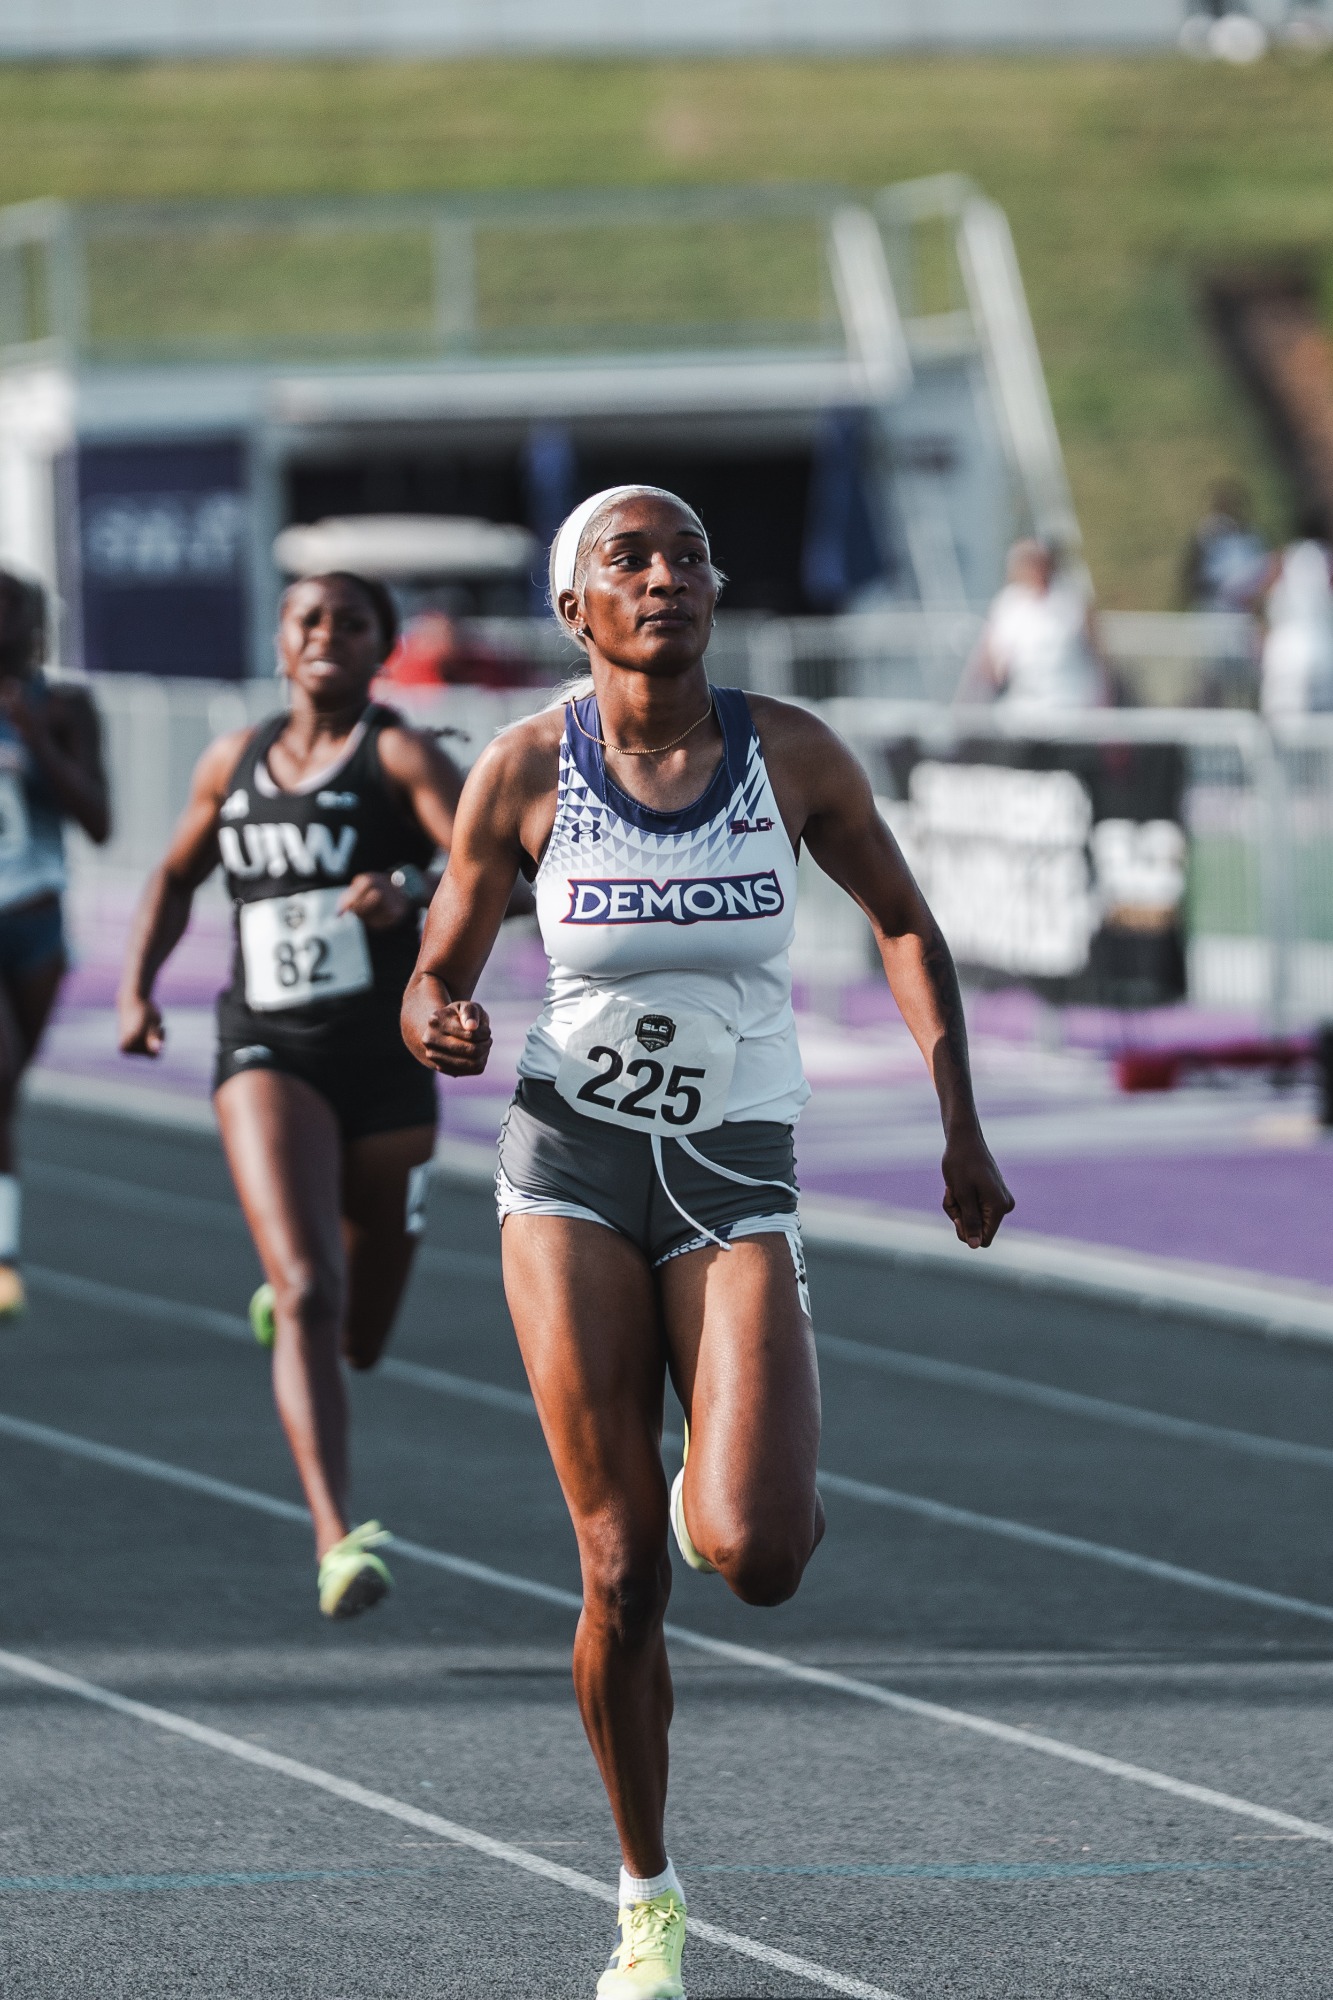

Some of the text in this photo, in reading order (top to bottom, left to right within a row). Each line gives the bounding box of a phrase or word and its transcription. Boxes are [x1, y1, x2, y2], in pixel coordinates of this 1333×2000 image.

[730, 817, 772, 835] SLC
[571, 877, 782, 920] DEMONS
[273, 936, 334, 988] 82
[642, 1022, 668, 1034] SLC
[576, 1045, 707, 1126] 225
